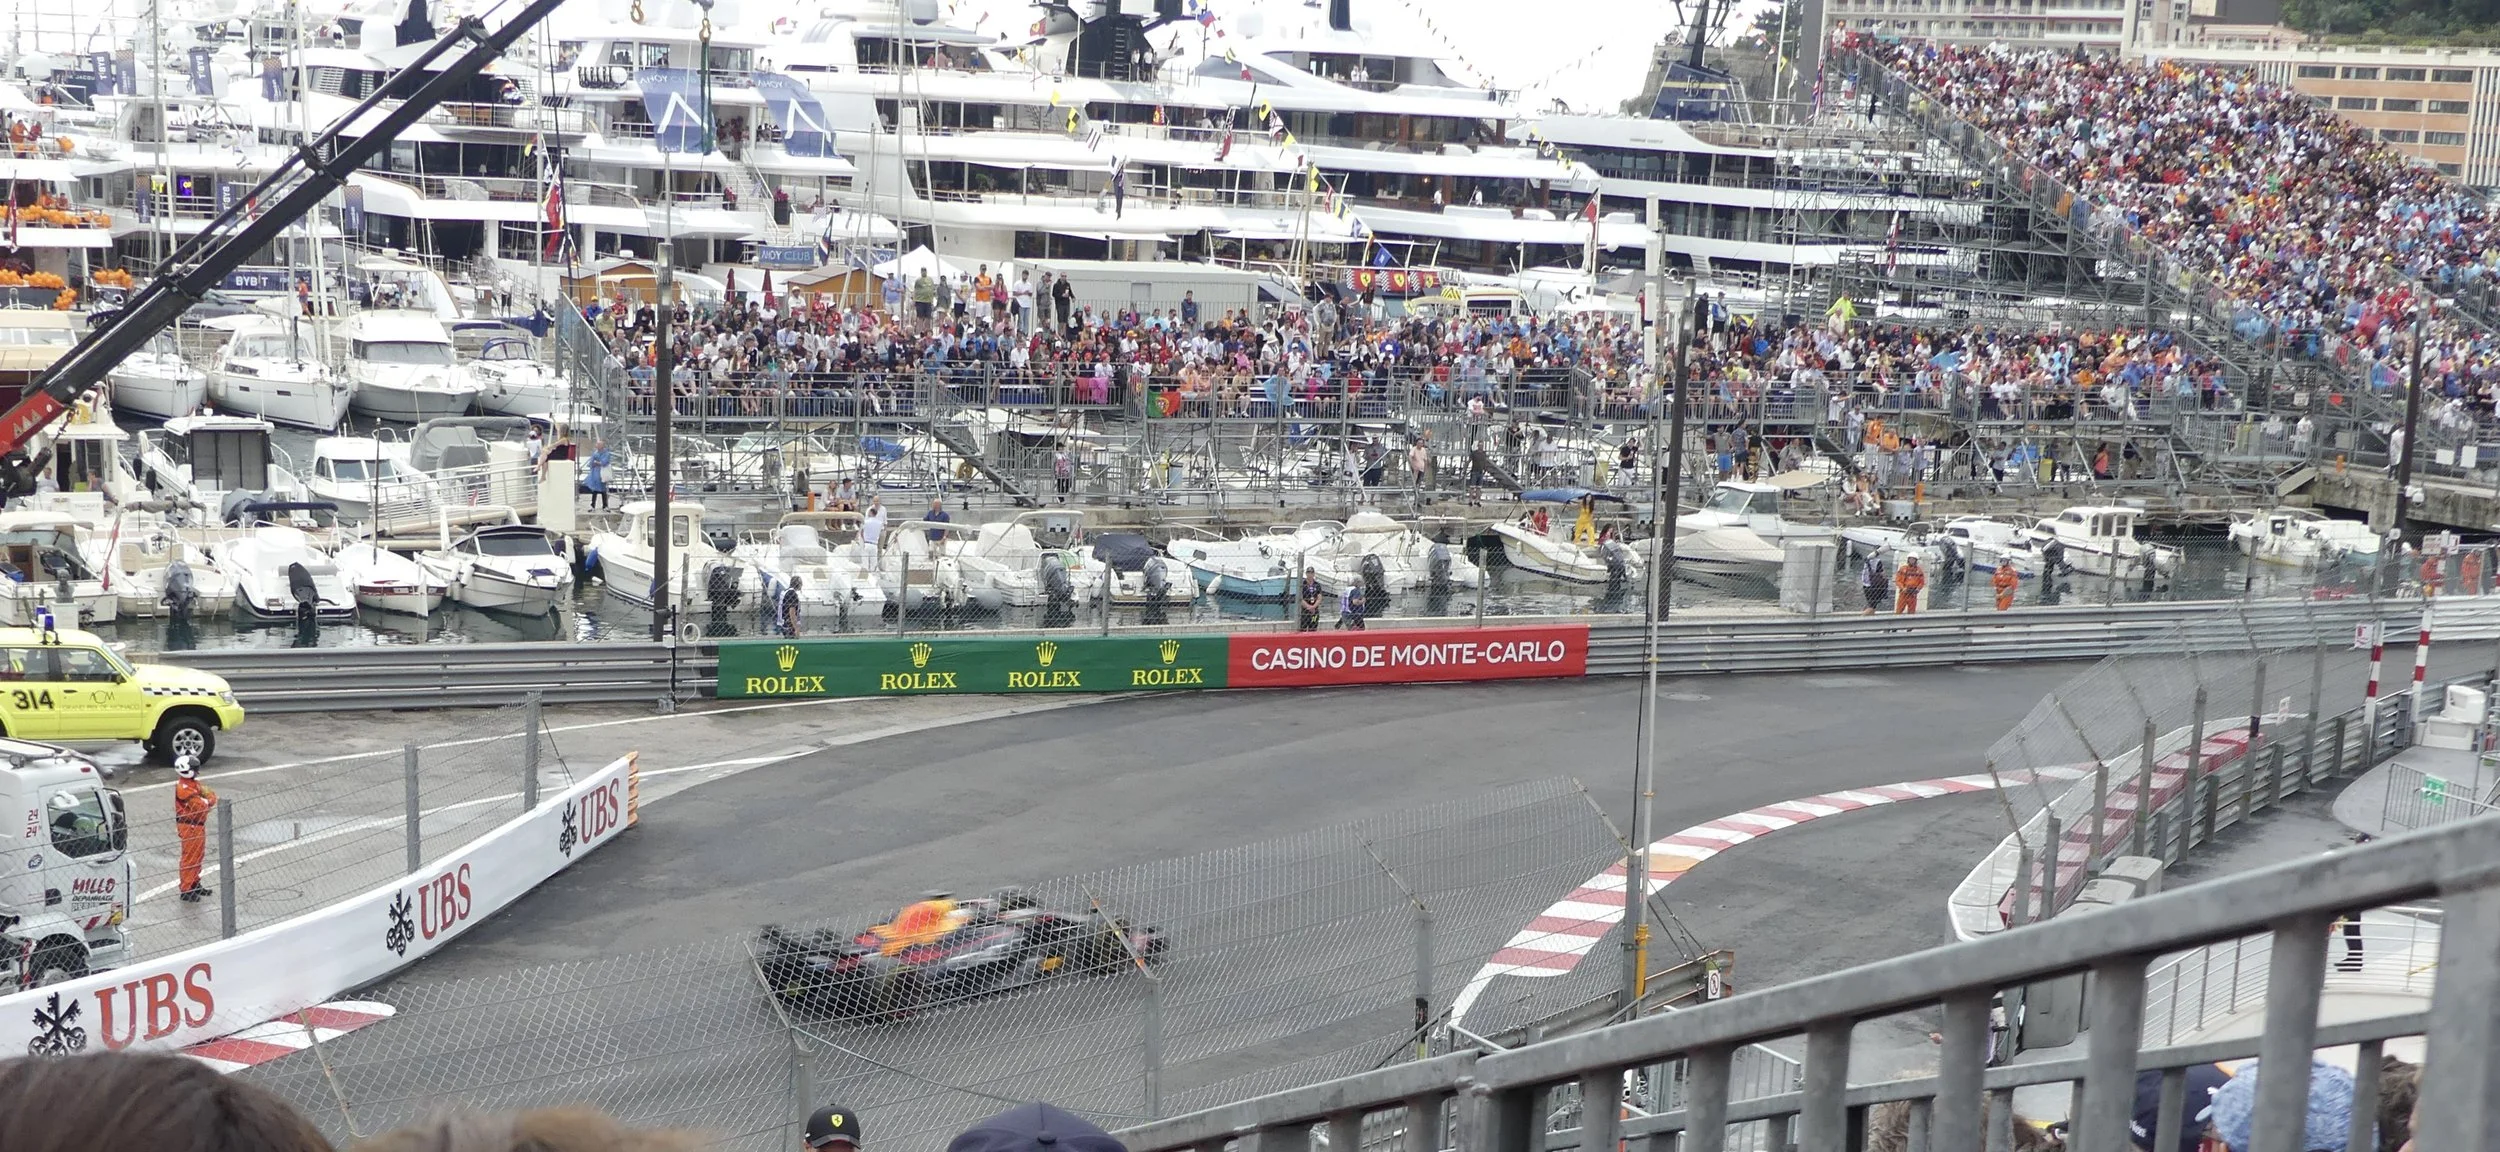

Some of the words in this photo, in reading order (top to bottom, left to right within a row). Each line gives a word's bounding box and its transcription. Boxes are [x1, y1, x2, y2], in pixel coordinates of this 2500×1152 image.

[783, 250, 811, 261] CLUB
[235, 275, 269, 287] BYBIT
[1251, 646, 1347, 671] CASINO
[1351, 645, 1386, 668] DE
[1391, 640, 1565, 667] MONTE-CARLO
[746, 675, 826, 694] ROLEX
[880, 672, 958, 690] ROLEX
[1007, 671, 1081, 688] ROLEX
[1132, 668, 1203, 686] ROLEX
[12, 689, 55, 710] 314
[580, 777, 619, 844] UBS
[72, 878, 116, 895] MILLO
[418, 863, 471, 941] UBS
[94, 962, 215, 1050] UBS
